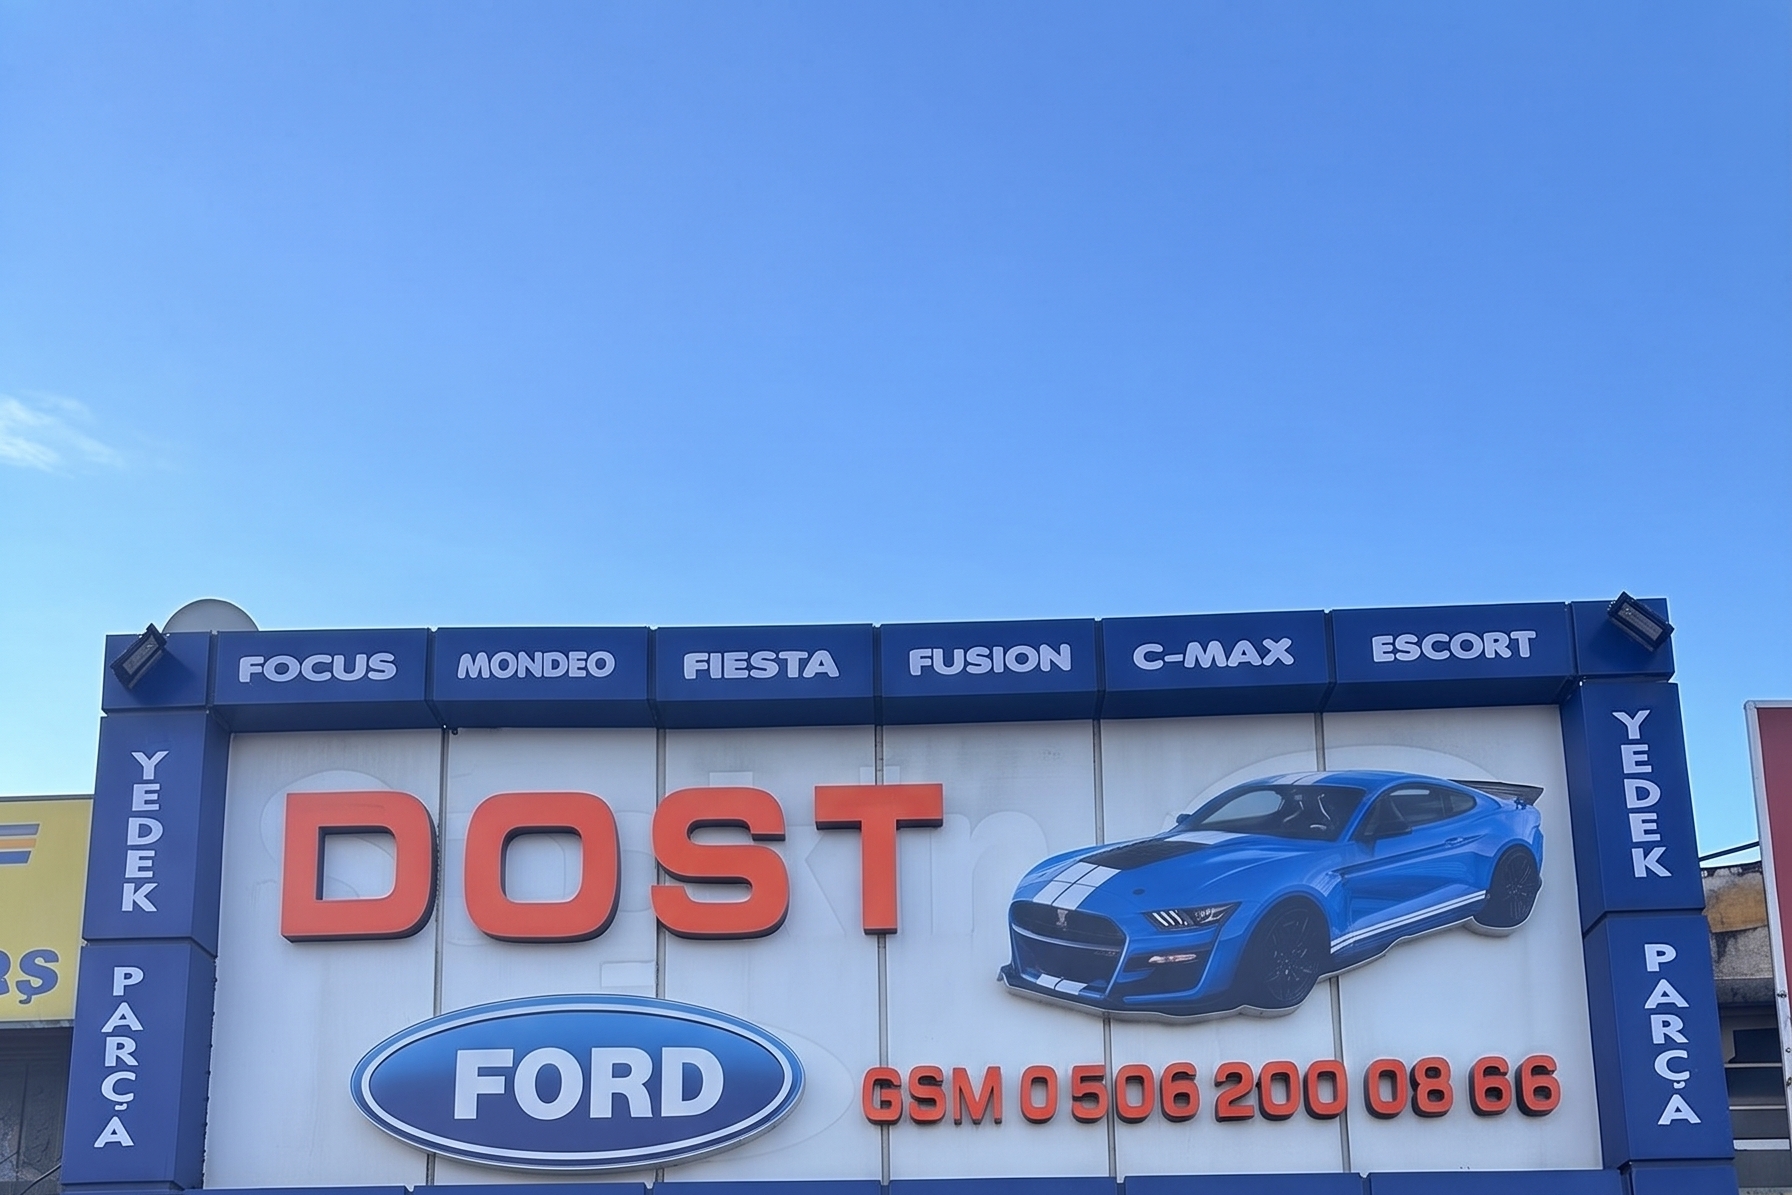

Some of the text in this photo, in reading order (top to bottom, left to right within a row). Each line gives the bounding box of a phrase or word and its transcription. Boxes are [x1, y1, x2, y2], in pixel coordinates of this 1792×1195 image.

[239, 652, 397, 683] FOCUS
[457, 651, 615, 679] MONDEO
[683, 650, 840, 679] FIESTA
[909, 644, 1071, 676] FUSION
[1133, 638, 1294, 670] C-MAX
[1372, 630, 1536, 662] ESCORT
[1612, 709, 1672, 878] YEDEK
[121, 750, 169, 912] YEDEK
[280, 785, 942, 942] DOST
[93, 966, 144, 1148] PARÇA
[1644, 943, 1702, 1125] PARÇA
[454, 1047, 724, 1121] FORD
[862, 1066, 1002, 1124] GSM
[1215, 1061, 1348, 1122] 200
[1364, 1058, 1453, 1117] 08
[1469, 1055, 1560, 1116] 66
